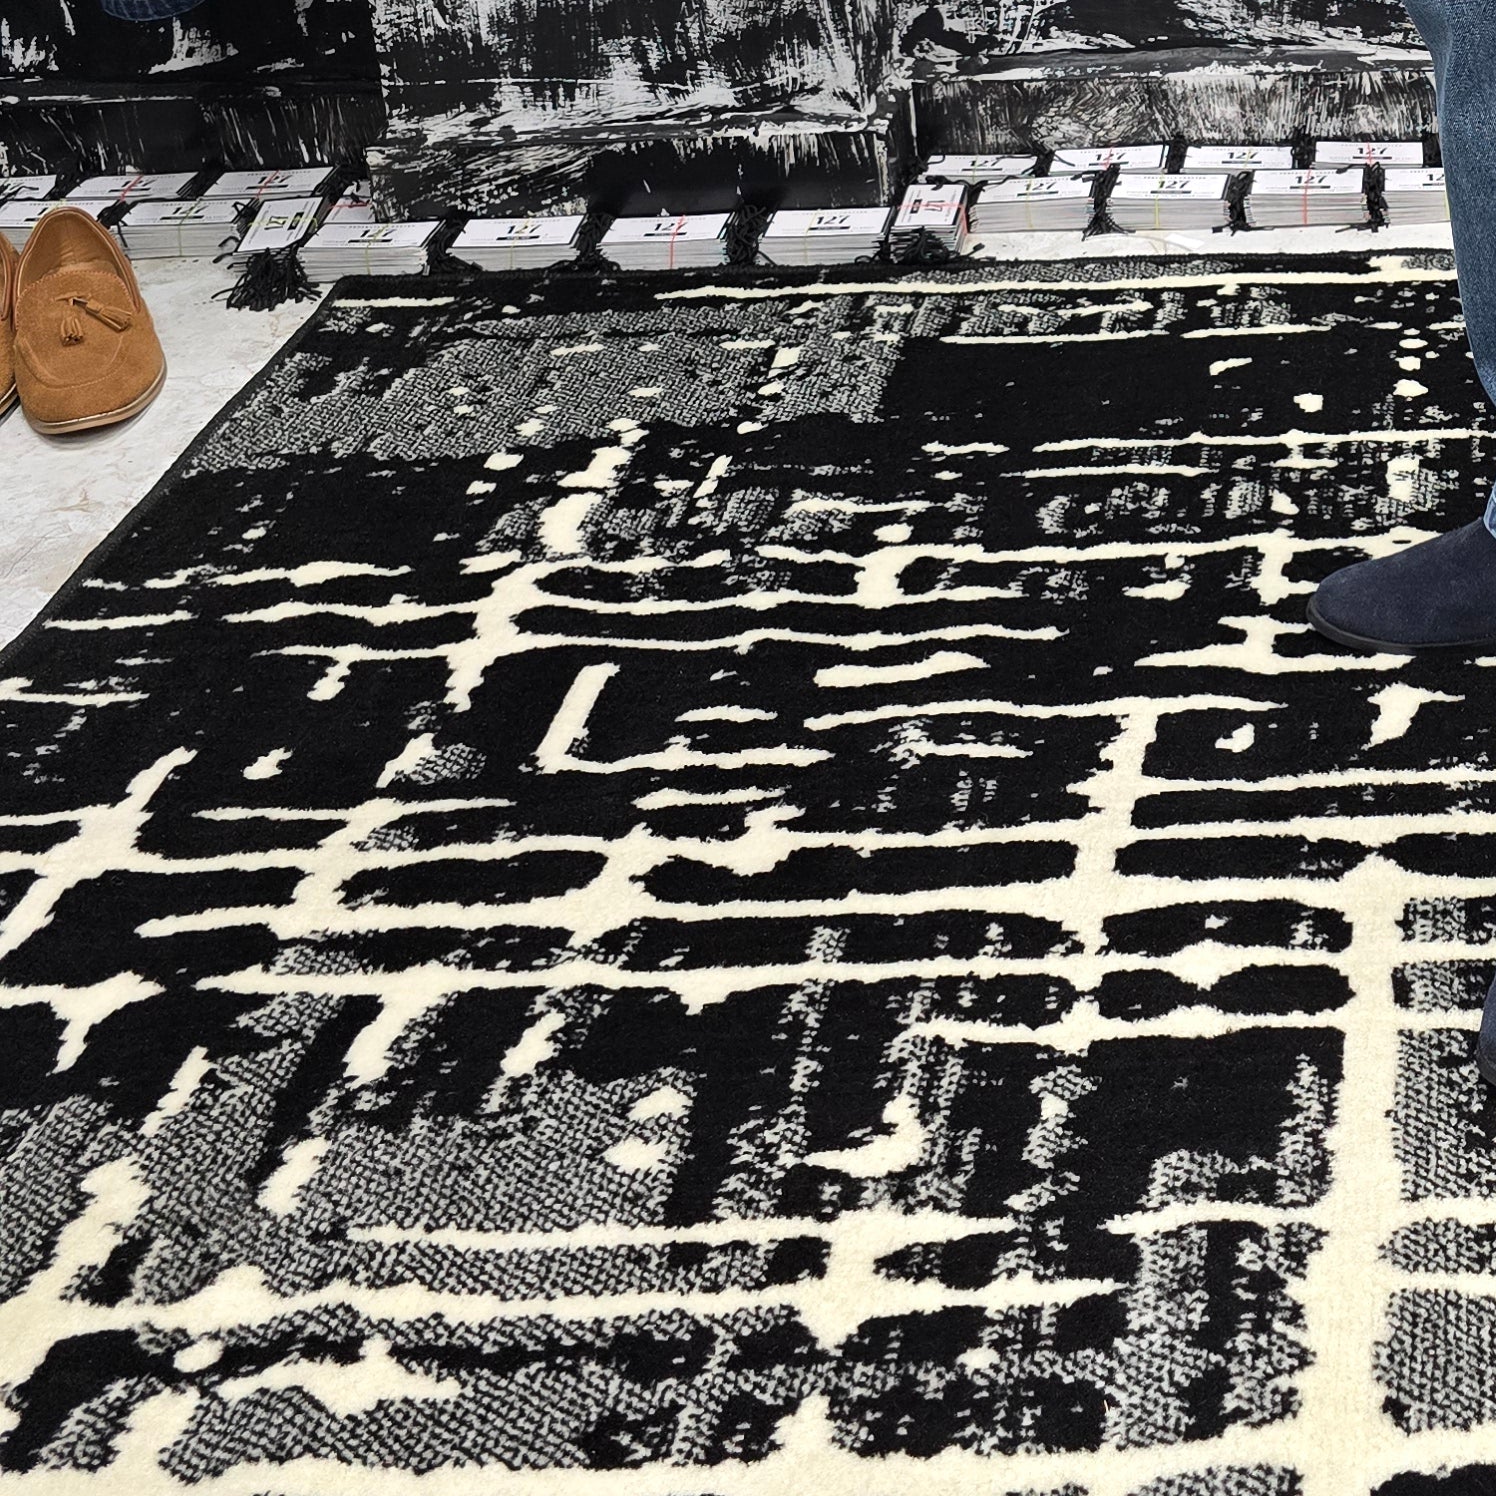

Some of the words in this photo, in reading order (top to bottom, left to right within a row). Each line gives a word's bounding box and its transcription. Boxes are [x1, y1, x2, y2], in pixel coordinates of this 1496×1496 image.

[1227, 151, 1259, 160] 127
[1295, 175, 1328, 184] 127
[1157, 180, 1191, 189] 127
[816, 215, 851, 225] 127
[507, 223, 543, 234] 127
